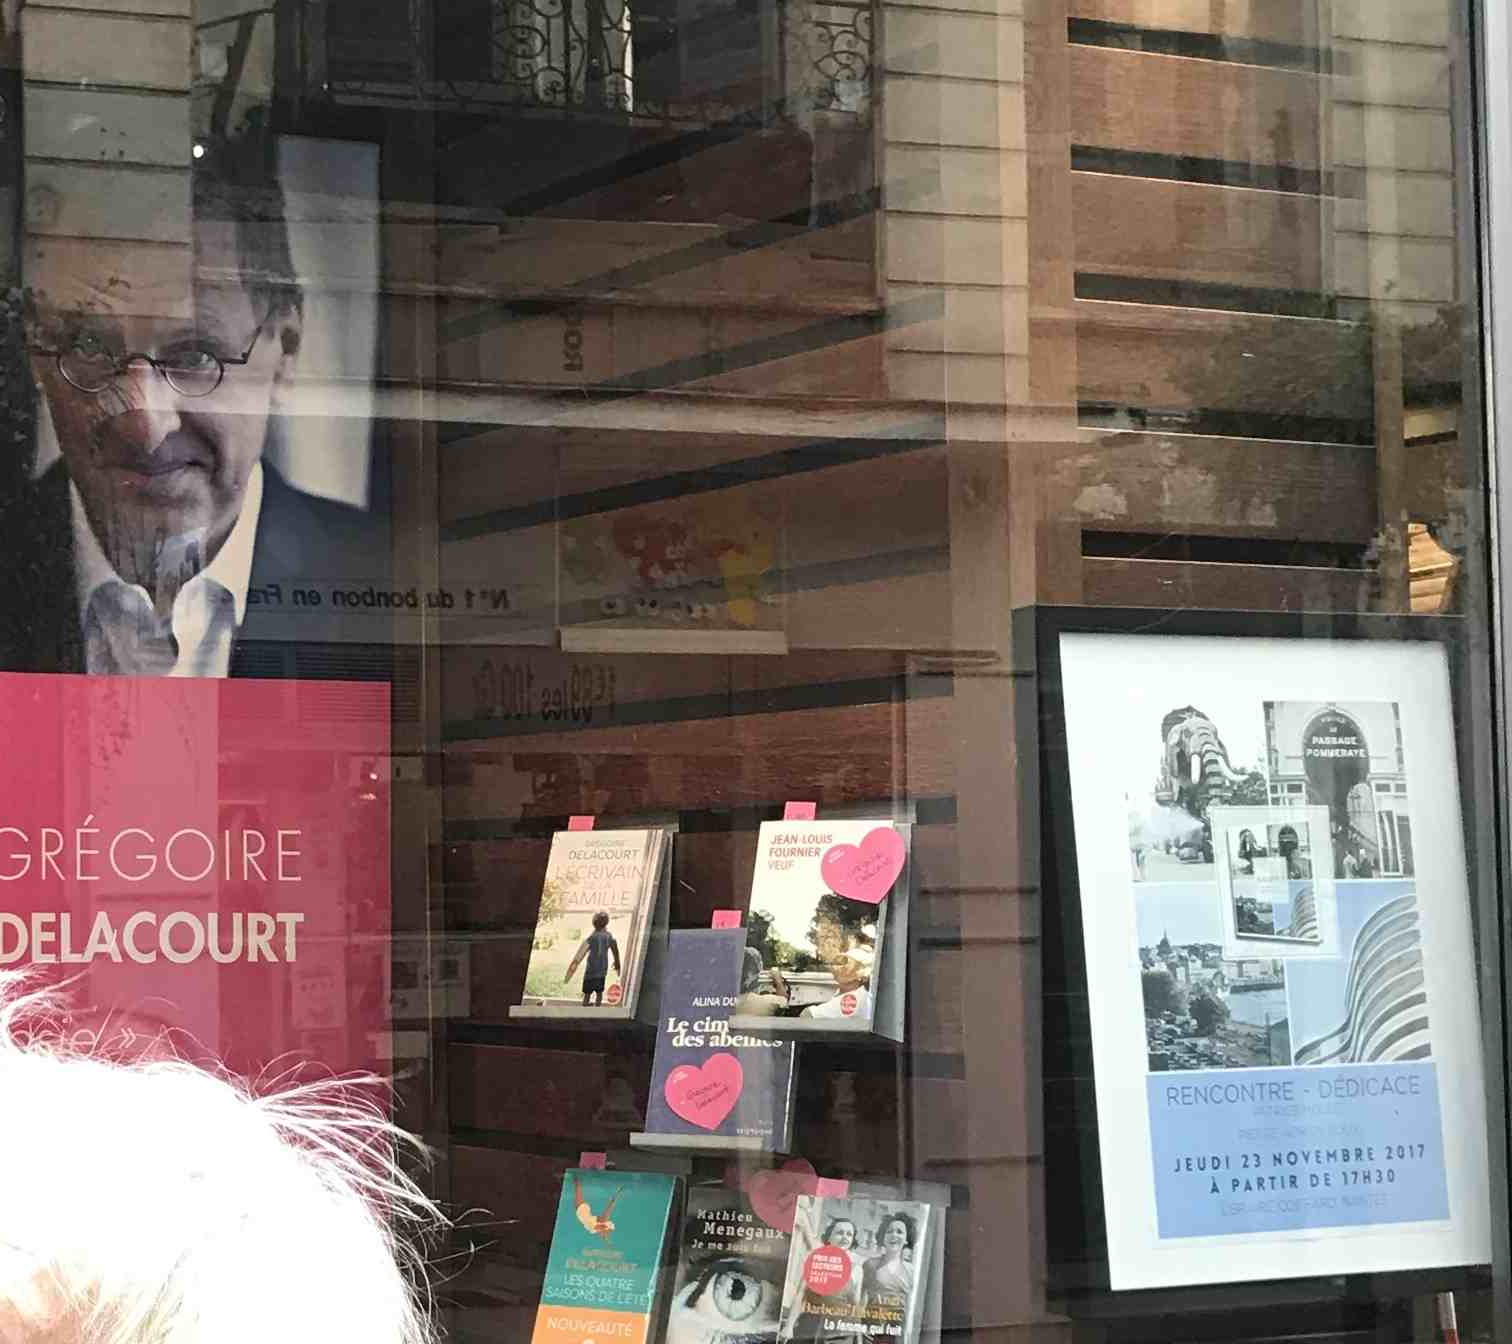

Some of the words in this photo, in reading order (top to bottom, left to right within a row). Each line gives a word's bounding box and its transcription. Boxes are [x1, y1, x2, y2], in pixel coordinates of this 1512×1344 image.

[769, 847, 821, 857] FOURNIER
[692, 997, 721, 1007] ALINA
[667, 1017, 689, 1032] Le
[672, 1030, 704, 1047] des
[1167, 1082, 1294, 1106] RENCONTRE
[1319, 1073, 1420, 1099] DÉDICACE
[1174, 1155, 1230, 1172] JEUDI
[1242, 1153, 1261, 1169] 23
[1273, 1147, 1375, 1166] NOVEMBRE
[1386, 1144, 1425, 1160] 2017
[1210, 1175, 1220, 1194] À
[1232, 1174, 1298, 1192] PARTIR
[1310, 1172, 1331, 1187] DE
[1343, 1168, 1395, 1185] 17H30
[697, 1209, 753, 1222] Mathieu
[564, 1274, 584, 1286] LES
[548, 1317, 633, 1336] NOUVEAUTÉ
